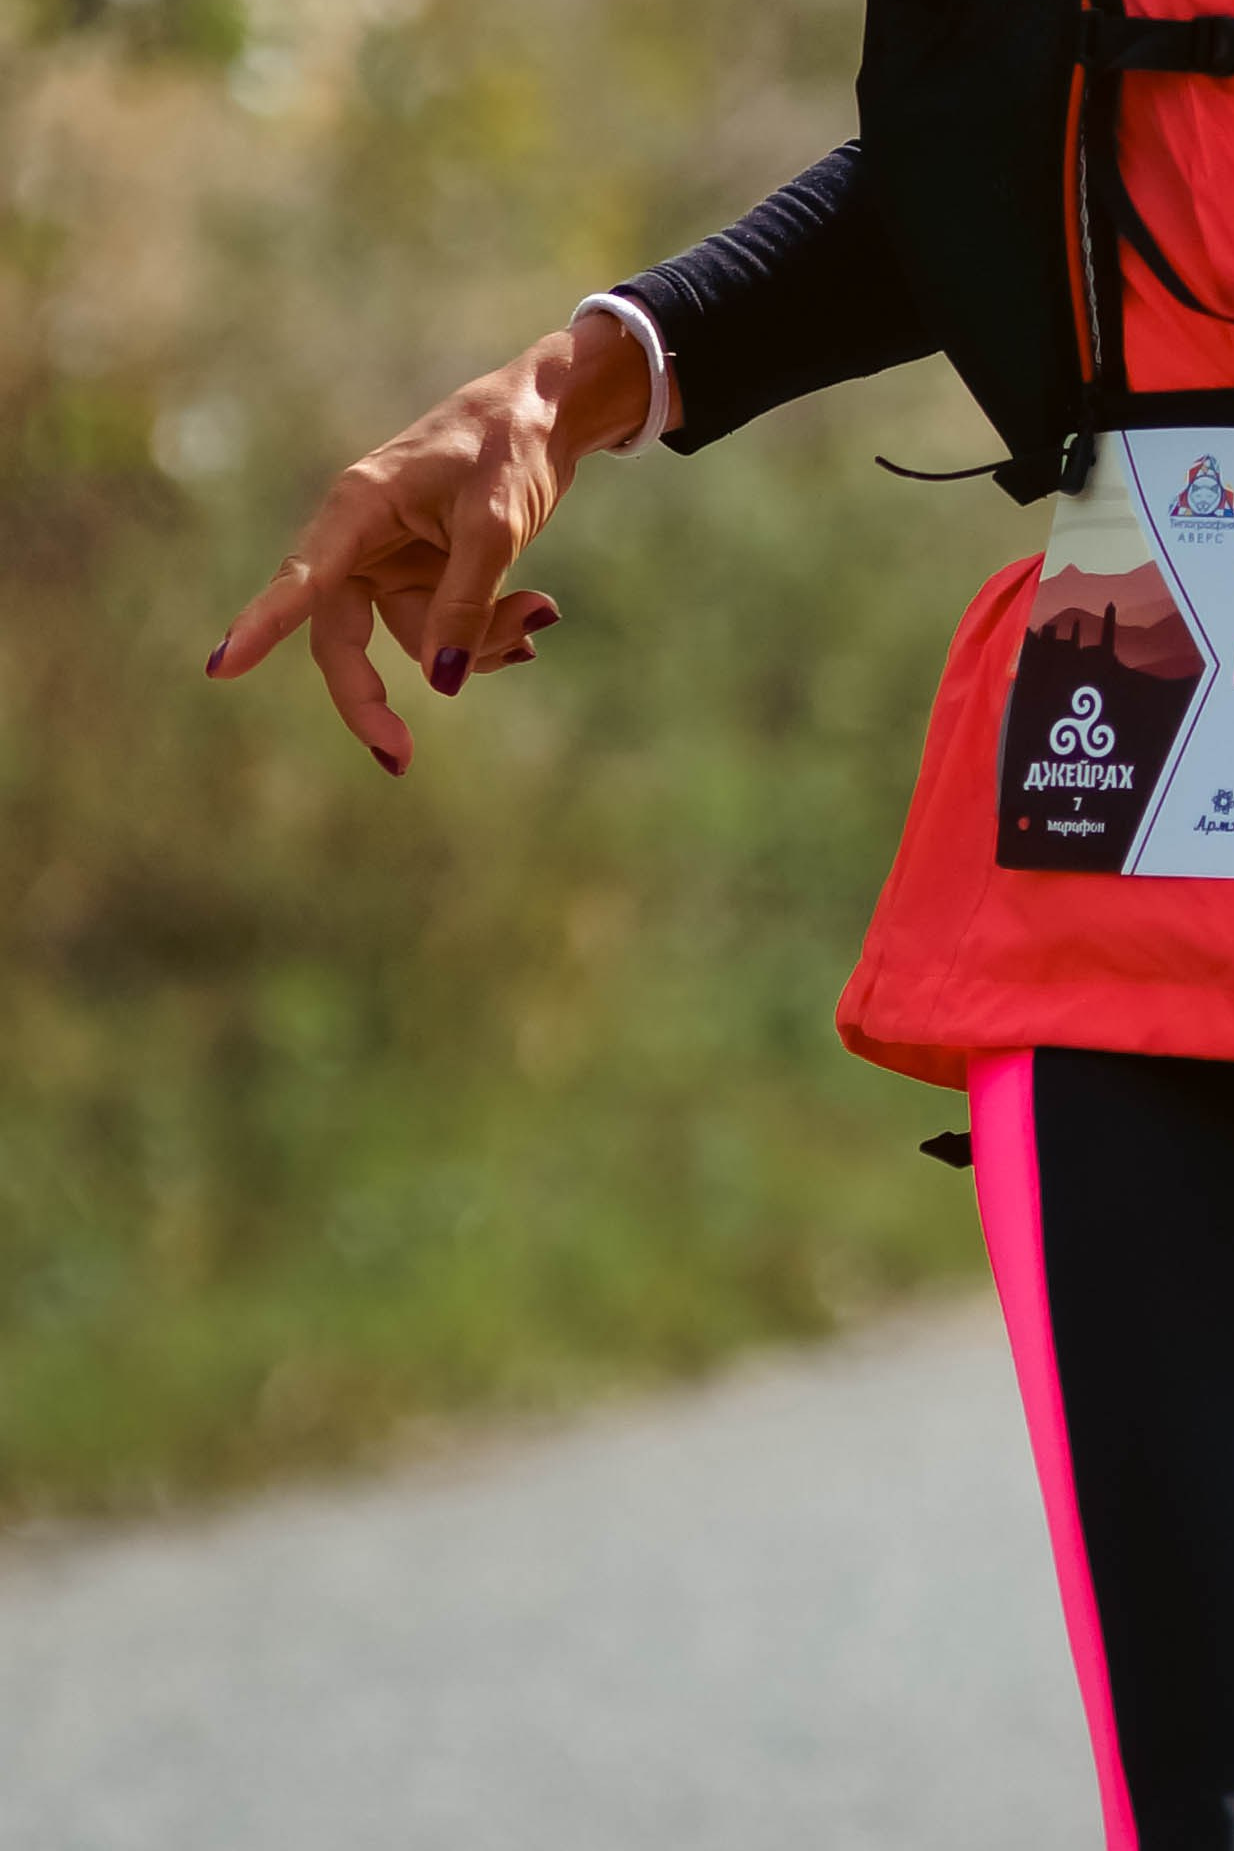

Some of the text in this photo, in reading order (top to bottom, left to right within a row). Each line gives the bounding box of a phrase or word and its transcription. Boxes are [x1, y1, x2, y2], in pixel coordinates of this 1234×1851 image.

[1023, 760, 1135, 791] ДЖЕЙРАХ
[1072, 796, 1083, 812] 7
[1046, 819, 1105, 837] марафон
